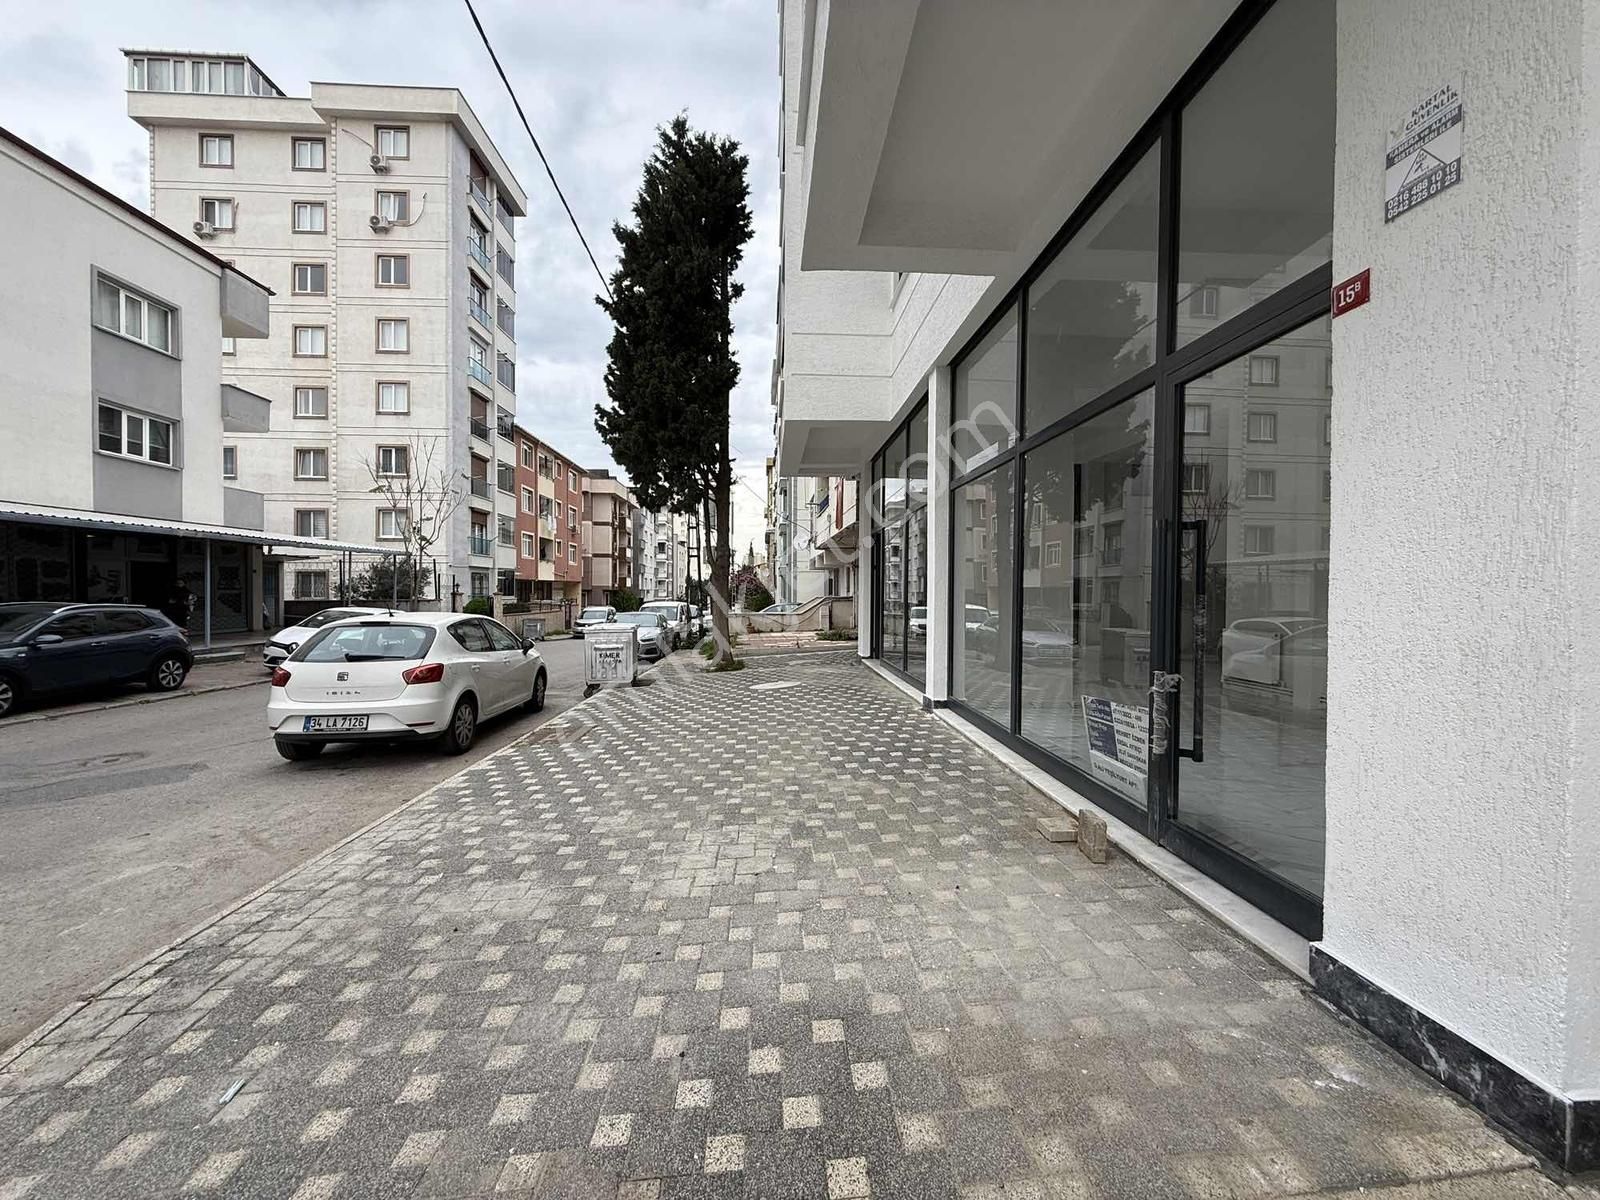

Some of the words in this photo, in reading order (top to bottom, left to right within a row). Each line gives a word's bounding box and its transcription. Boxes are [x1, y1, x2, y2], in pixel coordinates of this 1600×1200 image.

[1411, 84, 1452, 118] KARTAL
[1388, 191, 1409, 210] 0216
[1431, 170, 1442, 183] 10
[1446, 161, 1457, 174] 10
[1410, 188, 1428, 206] 225
[1430, 181, 1441, 194] 01
[1444, 171, 1457, 186] 25
[310, 718, 322, 728] 34
[326, 718, 337, 728] LA
[341, 716, 365, 728] 7126
